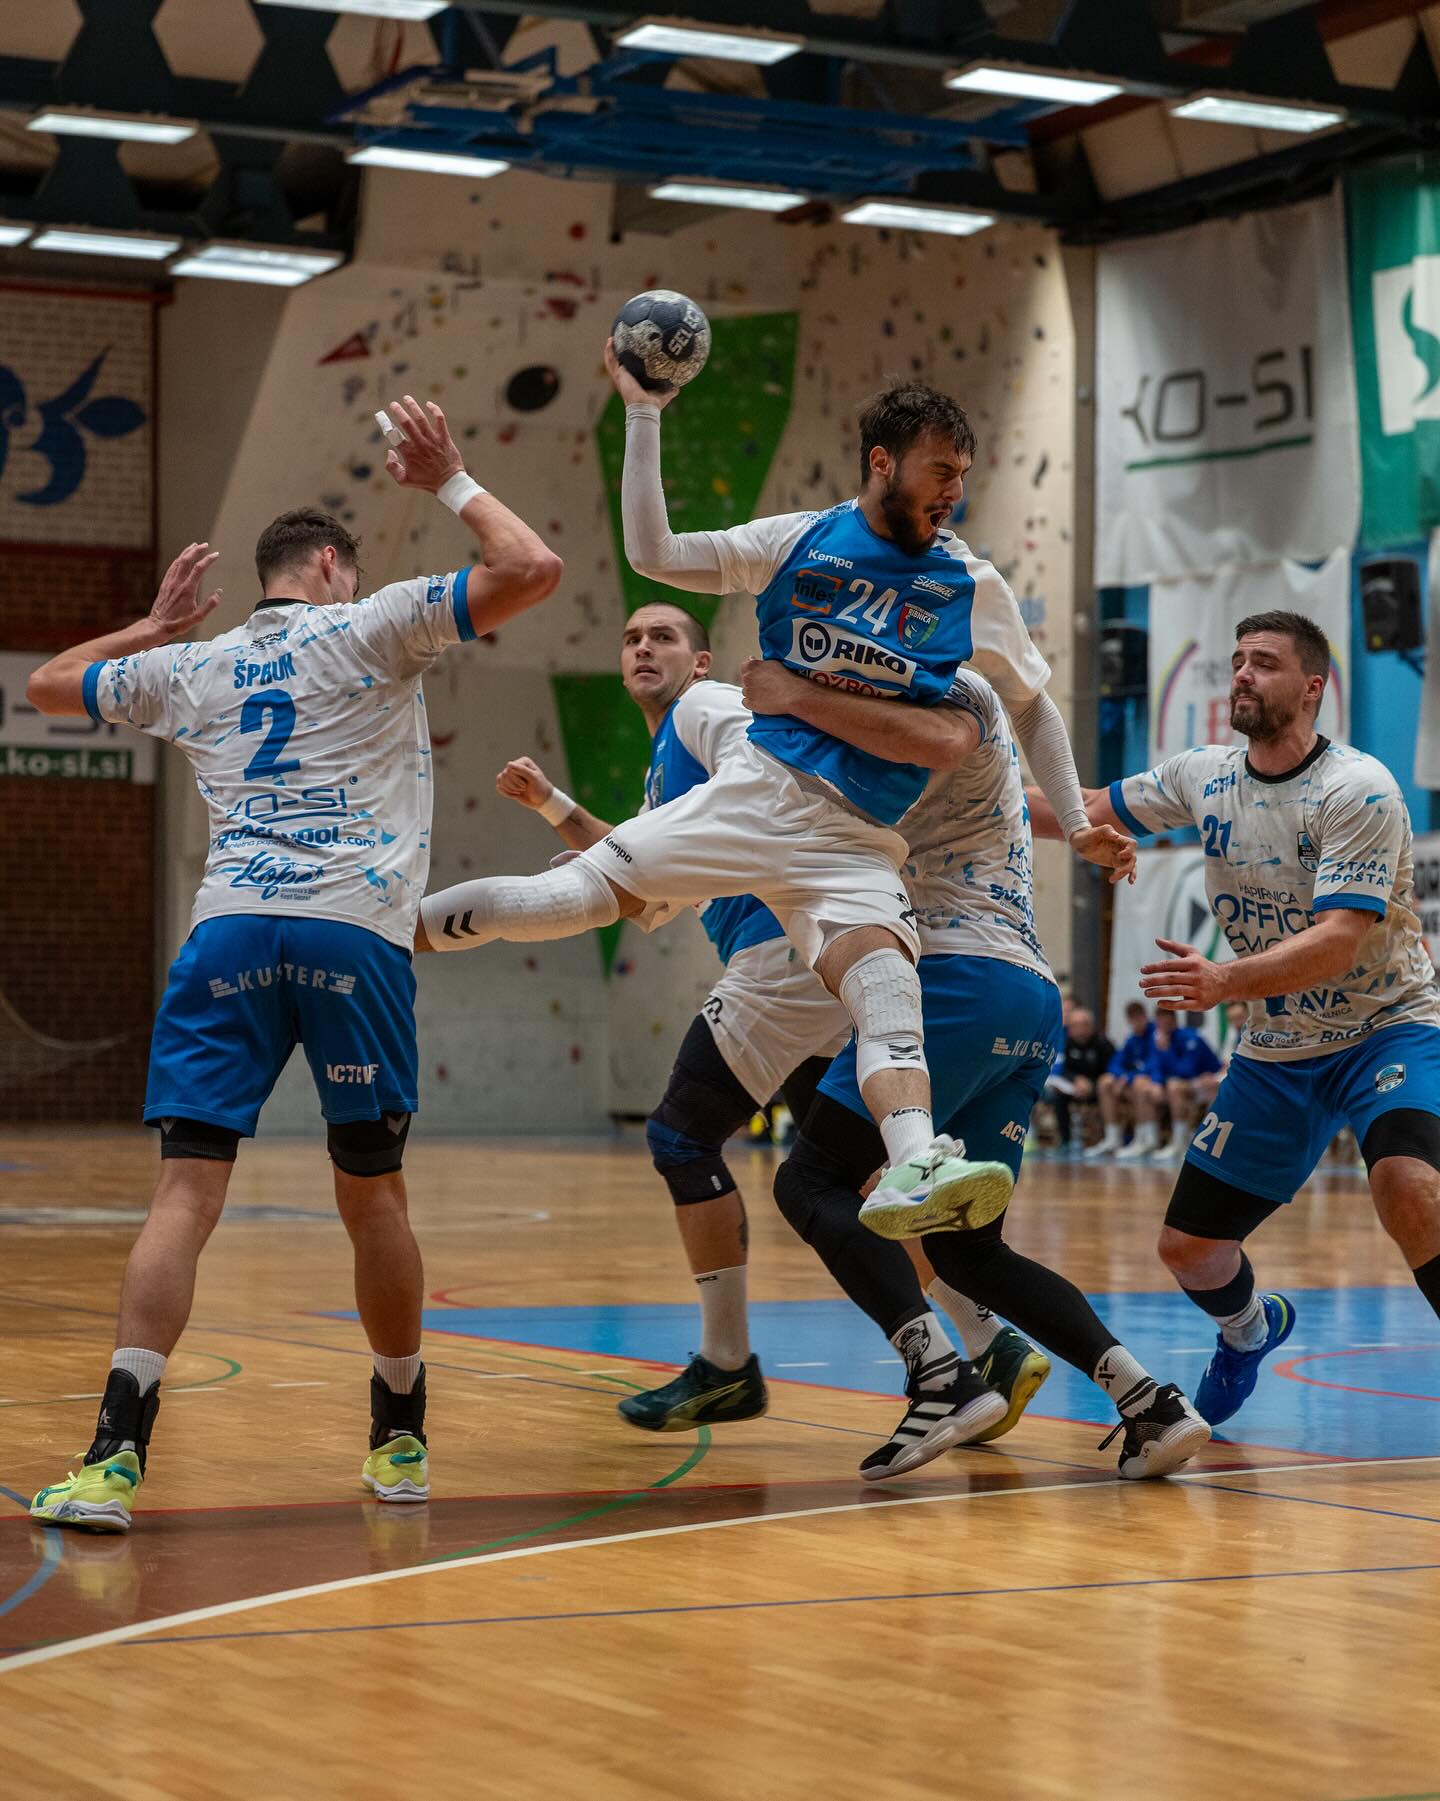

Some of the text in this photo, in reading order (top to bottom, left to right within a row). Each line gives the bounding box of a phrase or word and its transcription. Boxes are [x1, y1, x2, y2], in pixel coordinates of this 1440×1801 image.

[808, 549, 853, 569] Kempa
[913, 575, 957, 598] Sitomat
[835, 579, 899, 636] 24
[832, 638, 907, 675] RIKO
[240, 689, 301, 782] 2
[603, 835, 632, 864] Kempa
[1203, 814, 1233, 860] 21
[1336, 860, 1387, 874] STARA
[1193, 1112, 1234, 1158] 21
